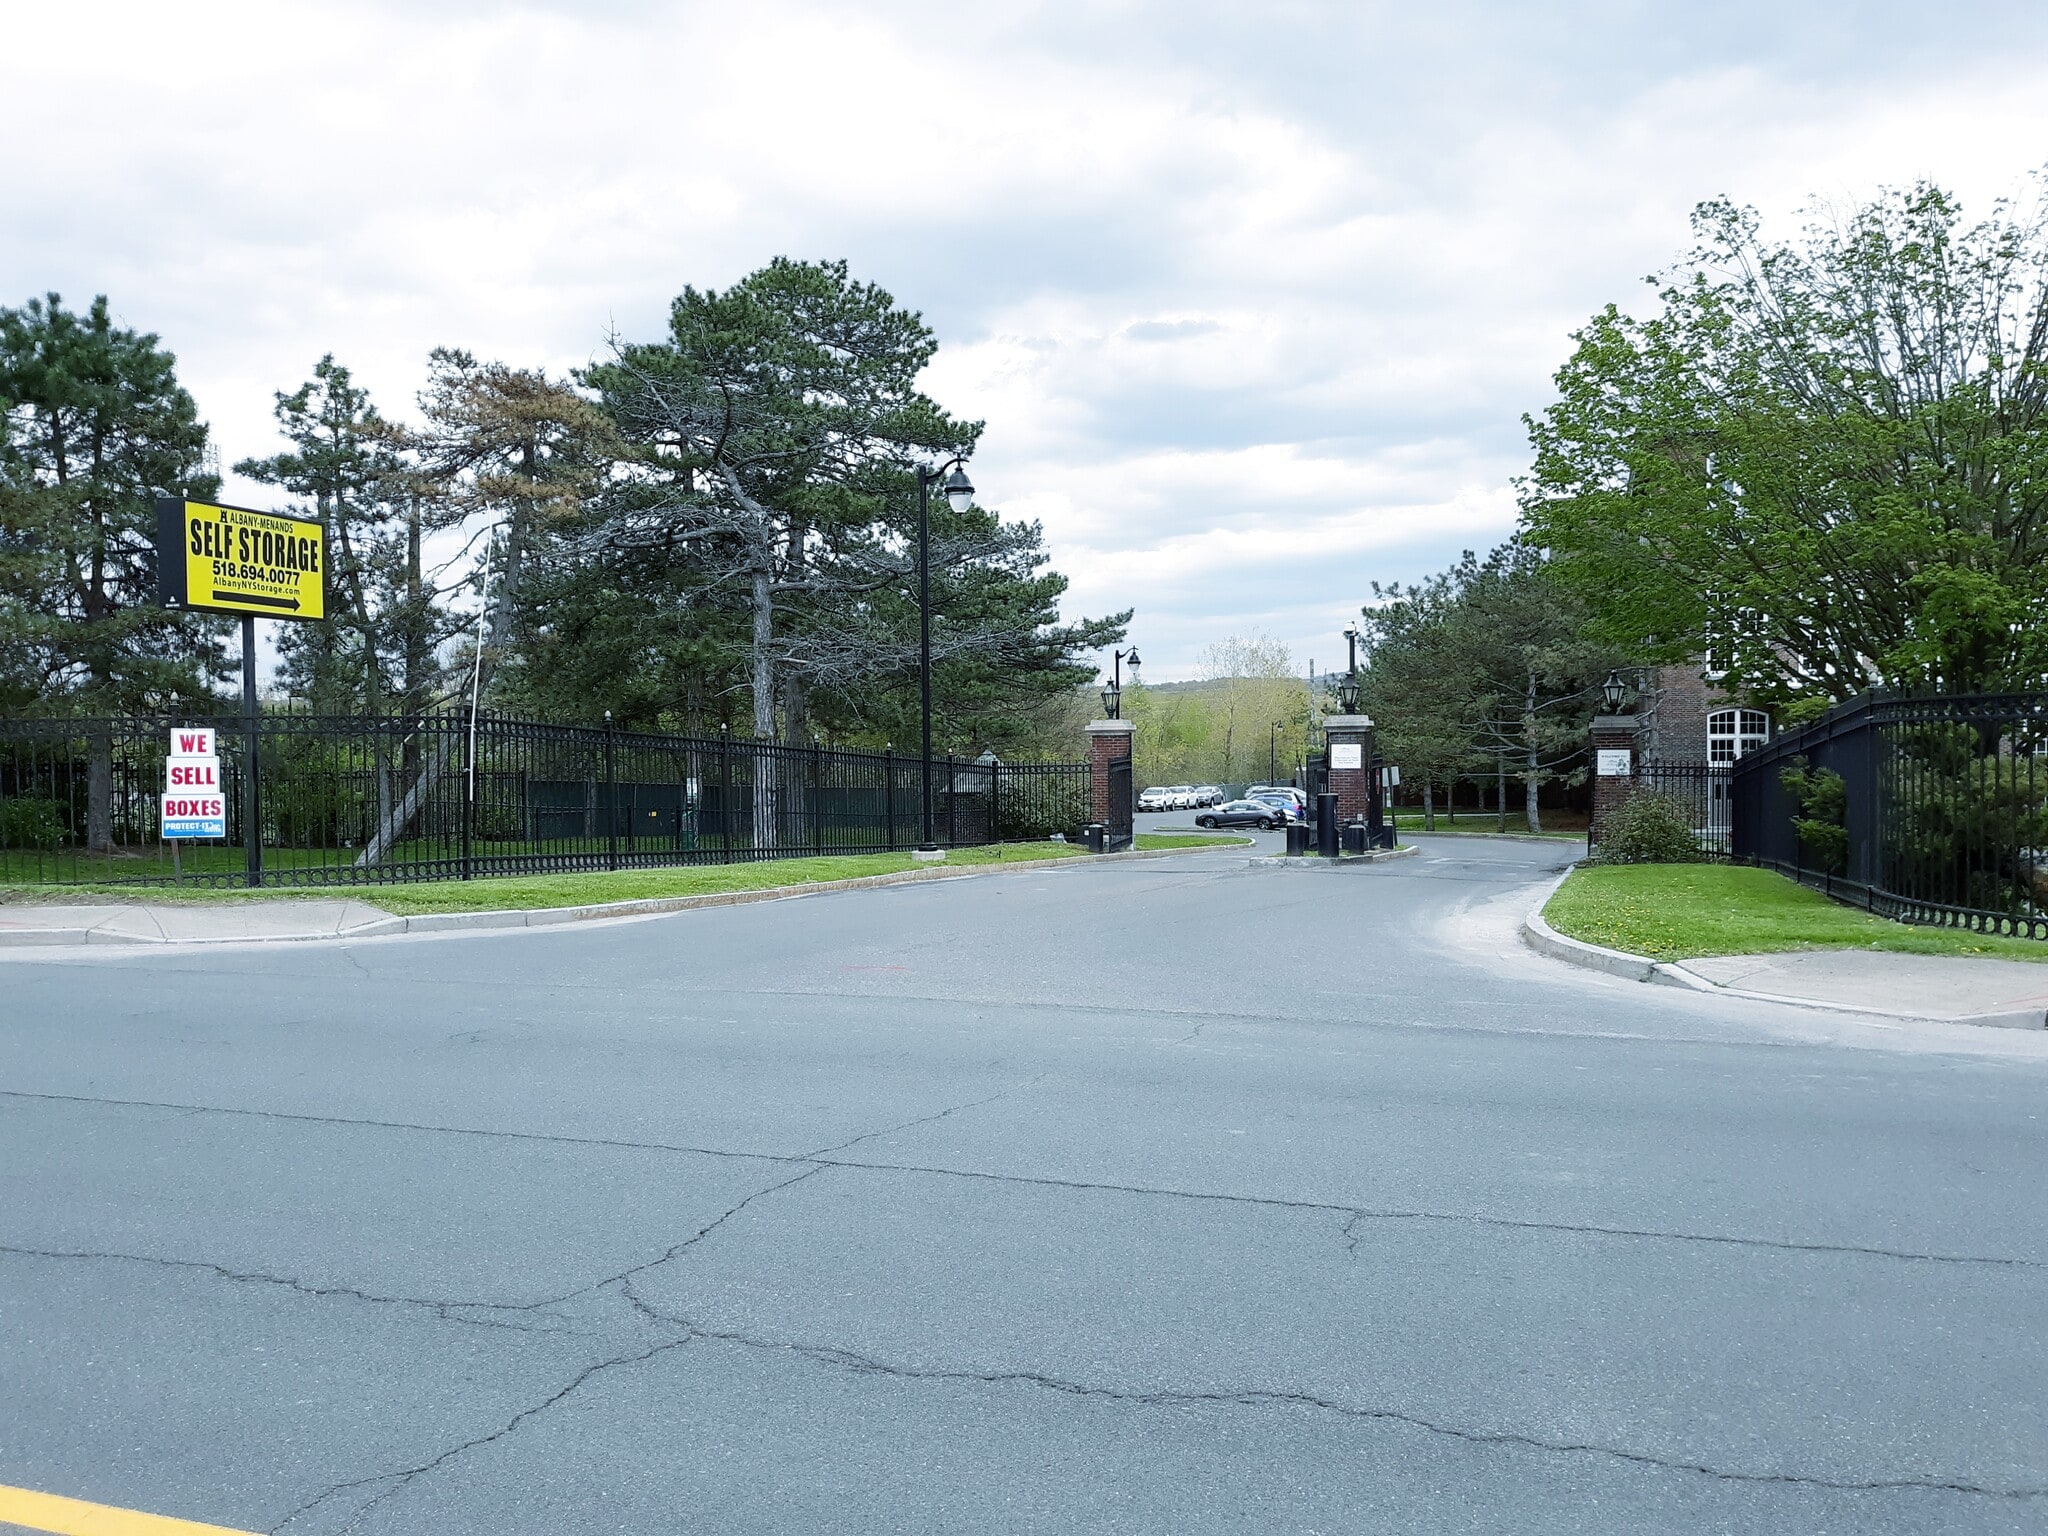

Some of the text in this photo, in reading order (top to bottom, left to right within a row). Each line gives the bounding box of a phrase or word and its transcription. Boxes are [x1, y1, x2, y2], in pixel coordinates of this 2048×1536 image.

[230, 512, 294, 534] ALBANY-MENANDS
[190, 518, 319, 573] SELF STORAGE
[212, 560, 301, 586] 518.694.0077
[213, 577, 301, 595] AlbanyNYStorage.com
[179, 734, 207, 752] WE
[171, 767, 215, 785] SELL
[165, 800, 221, 816] BOXES
[165, 822, 208, 830] PROTECT-IT
